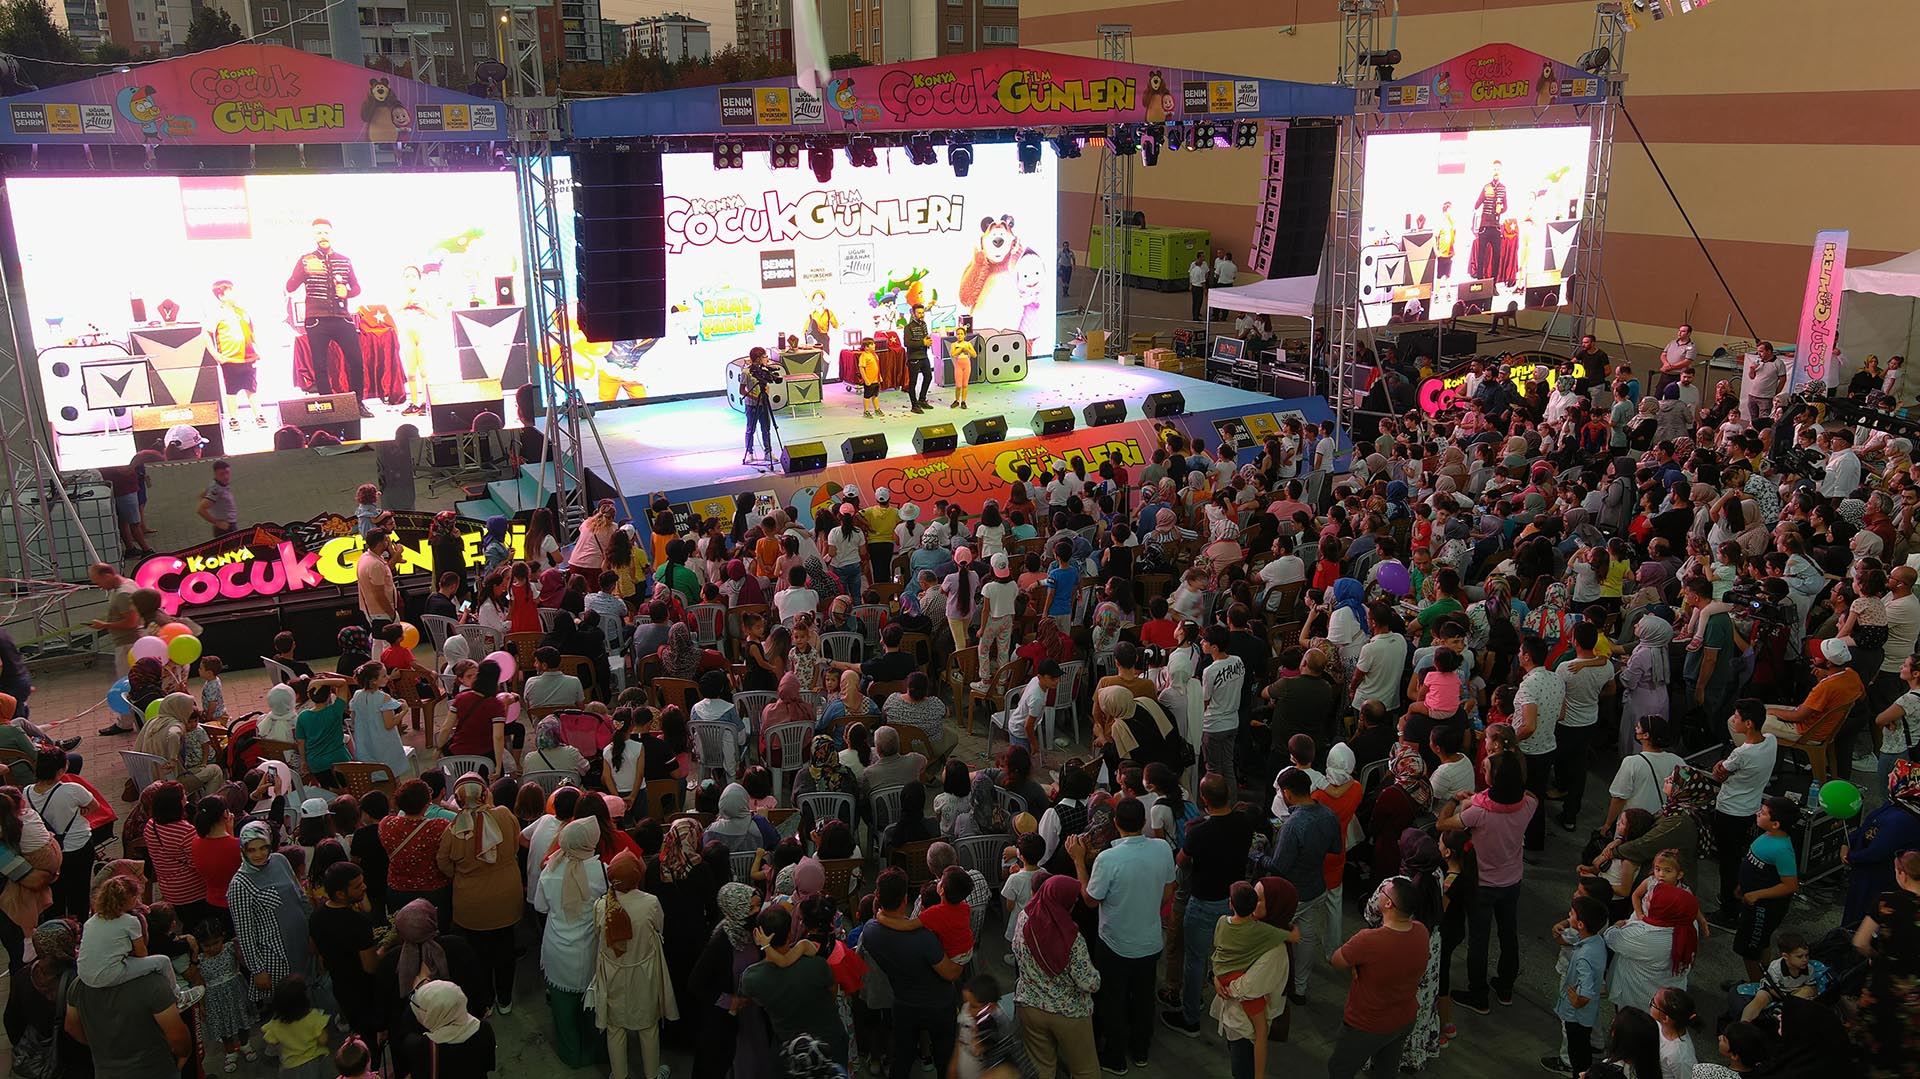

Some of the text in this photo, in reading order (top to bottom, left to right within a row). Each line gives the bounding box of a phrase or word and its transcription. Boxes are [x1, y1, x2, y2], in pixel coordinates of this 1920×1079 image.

[219, 67, 257, 80] KONYA
[912, 71, 956, 88] KONYA
[1022, 70, 1051, 83] FİLM
[998, 69, 1135, 114] GÜNLERİ
[1184, 89, 1207, 98] BENİM
[722, 97, 752, 107] BENİM
[794, 102, 822, 119] Altay
[14, 111, 43, 119] BENİM
[212, 101, 344, 134] GÜNLERİ
[723, 107, 753, 117] ŞEHRİM
[15, 119, 44, 128] ŞEHRİM
[691, 194, 747, 215] KONYA
[797, 190, 964, 240] GÜNLERİ
[704, 297, 752, 315] KRAL
[702, 312, 755, 339] ŞAKİR
[1018, 445, 1048, 460] FİLM
[904, 460, 950, 481] KONYA
[187, 546, 255, 573] KONYA
